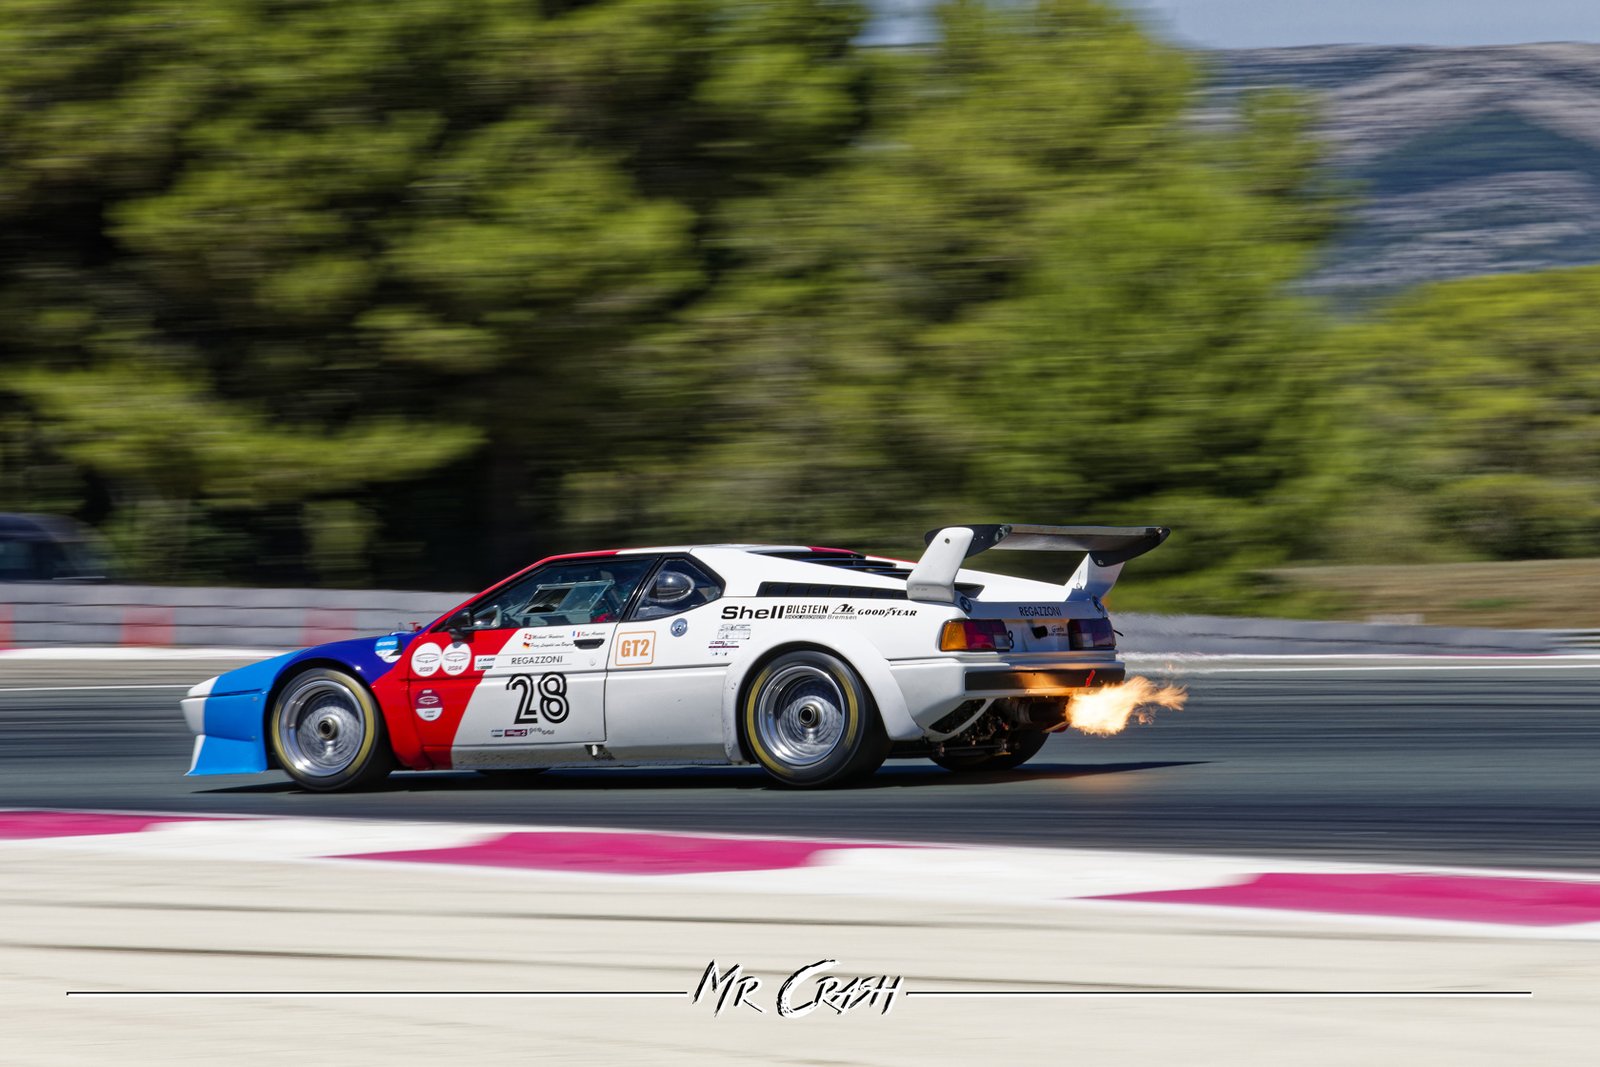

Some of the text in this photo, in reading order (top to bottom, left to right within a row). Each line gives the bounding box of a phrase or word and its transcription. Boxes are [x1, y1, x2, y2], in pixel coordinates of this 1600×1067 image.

[721, 605, 785, 619] Shell
[786, 604, 829, 614] BILSTEIN
[1018, 606, 1062, 617] REGAZZONI
[620, 639, 650, 657] GT2
[511, 655, 563, 665] REGAZZONI
[506, 671, 570, 724] 28
